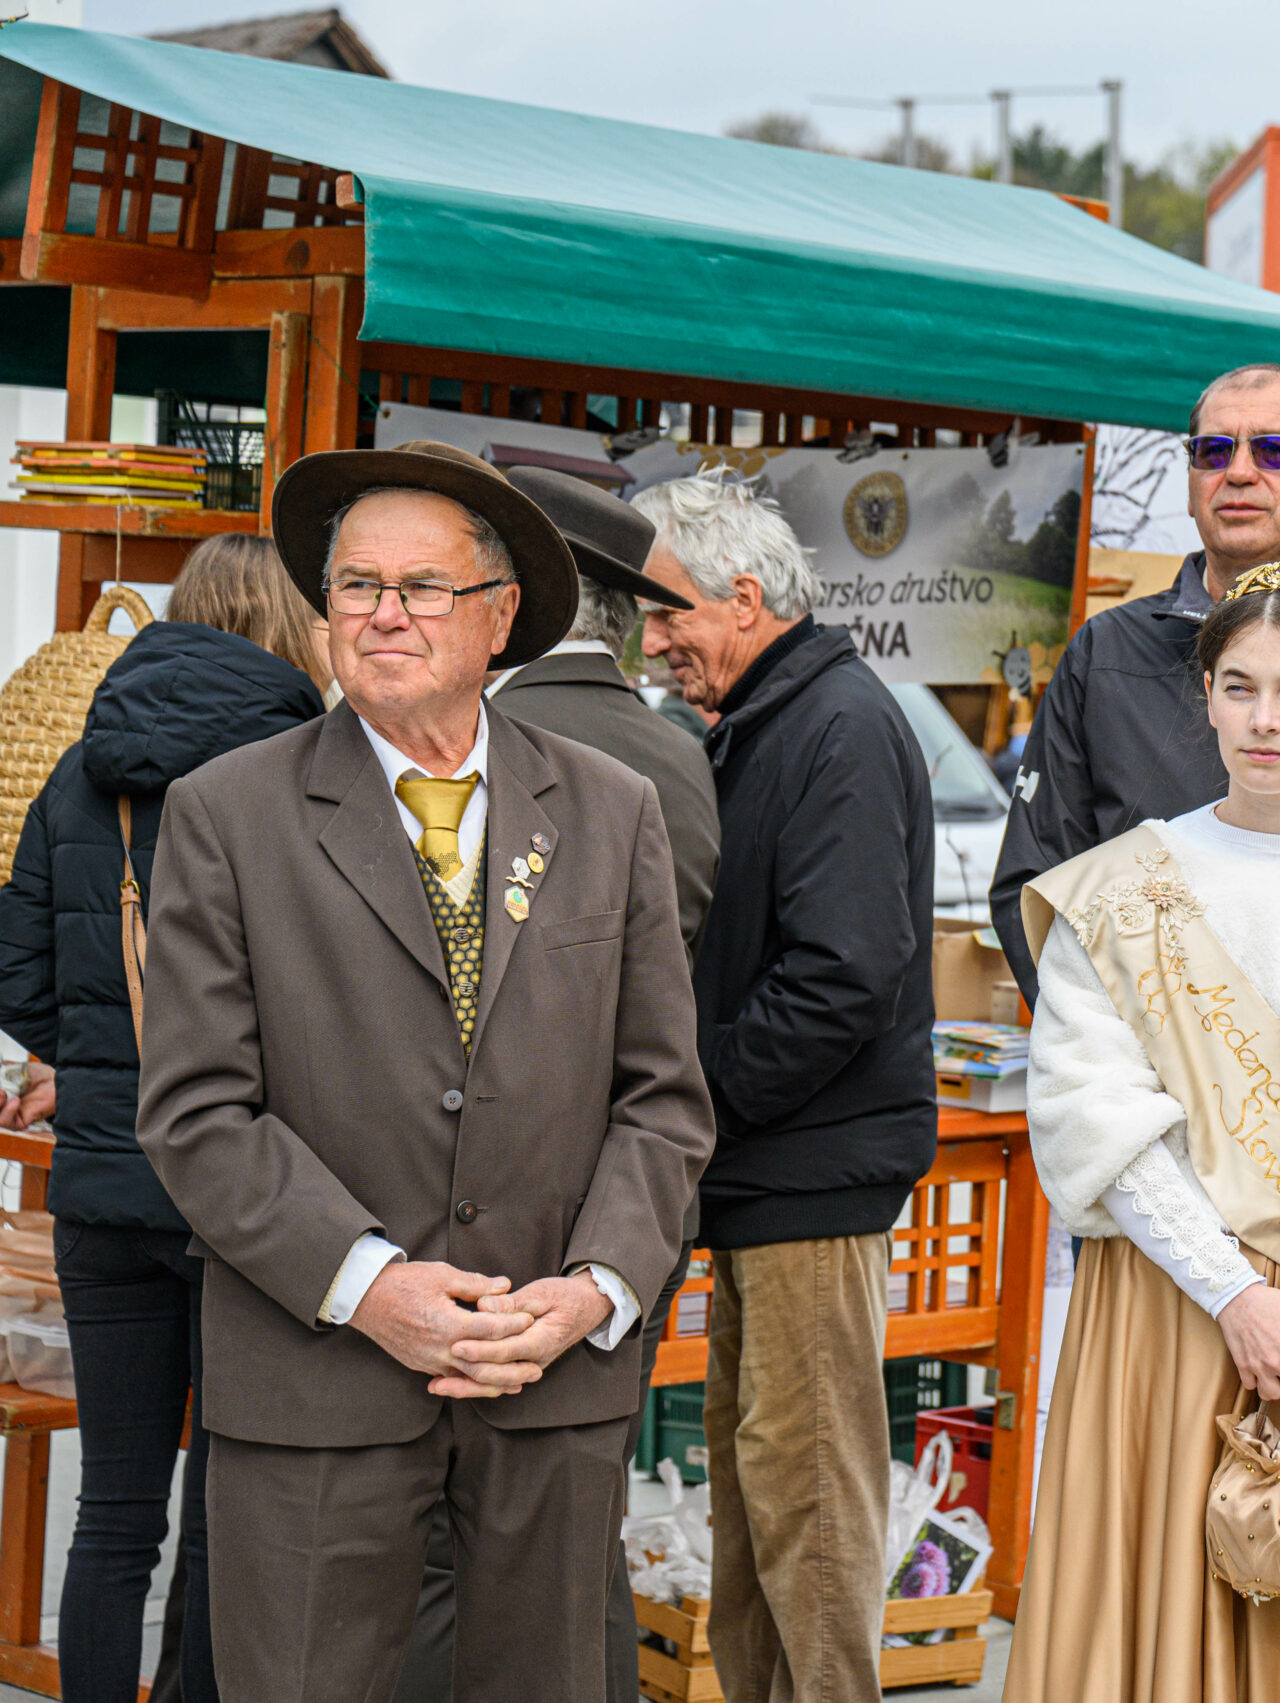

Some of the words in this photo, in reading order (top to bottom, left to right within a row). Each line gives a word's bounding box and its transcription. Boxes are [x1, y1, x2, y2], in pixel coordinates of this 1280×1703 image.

[813, 573, 884, 608] arsko
[889, 570, 994, 604] društvo
[1182, 610, 1206, 620] HELL
